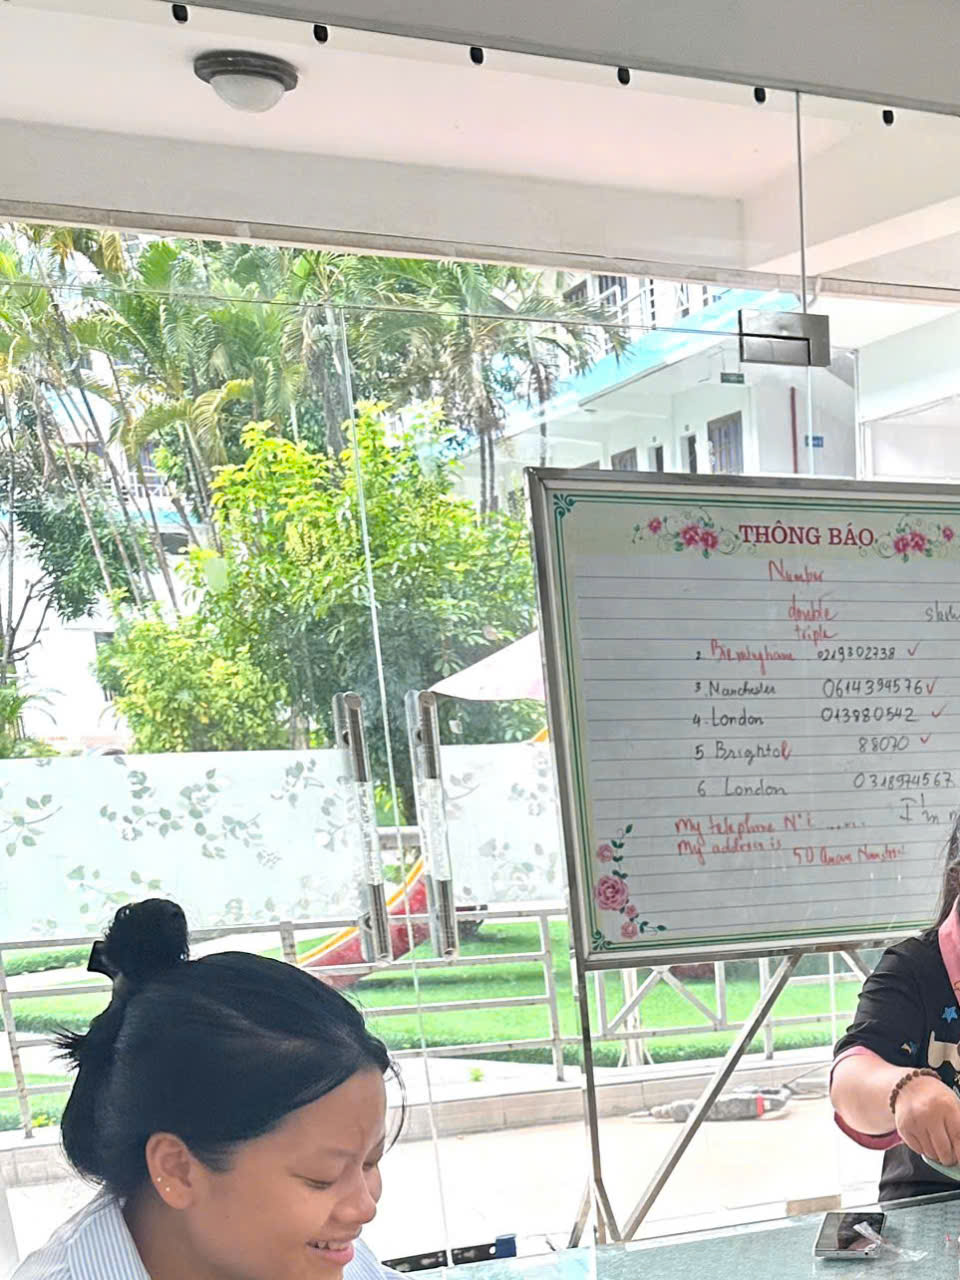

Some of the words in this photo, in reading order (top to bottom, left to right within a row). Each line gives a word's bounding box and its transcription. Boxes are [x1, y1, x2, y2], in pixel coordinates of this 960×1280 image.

[739, 520, 821, 545] THÔNG
[828, 523, 874, 546] BÁO
[711, 705, 764, 727] London
[697, 780, 706, 796] 6
[724, 777, 788, 797] London
